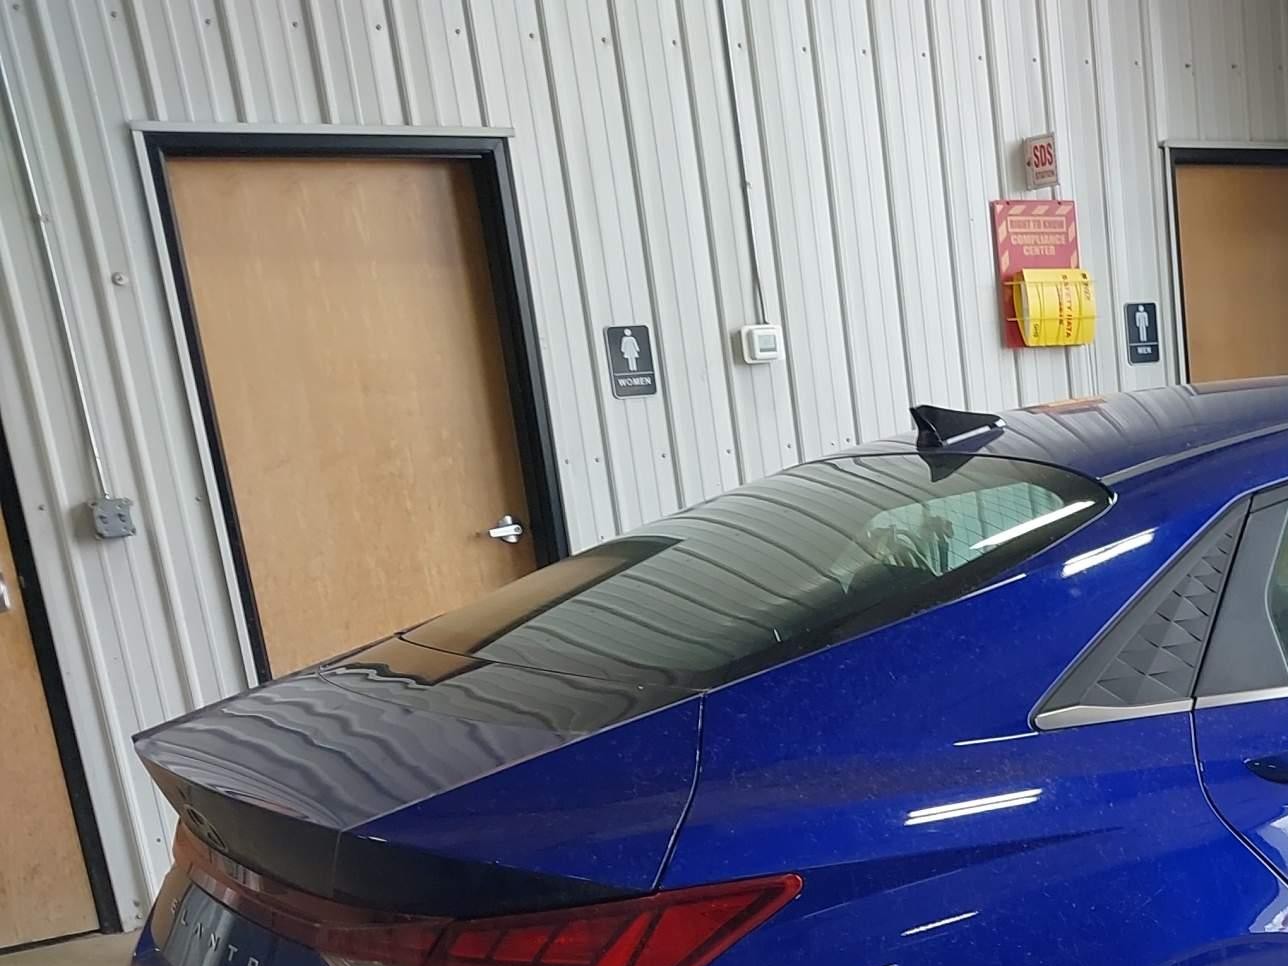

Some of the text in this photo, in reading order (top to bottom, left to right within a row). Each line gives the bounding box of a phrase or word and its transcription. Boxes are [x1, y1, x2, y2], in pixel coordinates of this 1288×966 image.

[1033, 142, 1054, 168] SDS
[1010, 234, 1066, 245] COMPLIANCE
[1023, 245, 1056, 256] CENTER
[1065, 314, 1073, 338] DATA
[1137, 346, 1152, 354] MEN
[617, 377, 652, 387] WOMEN
